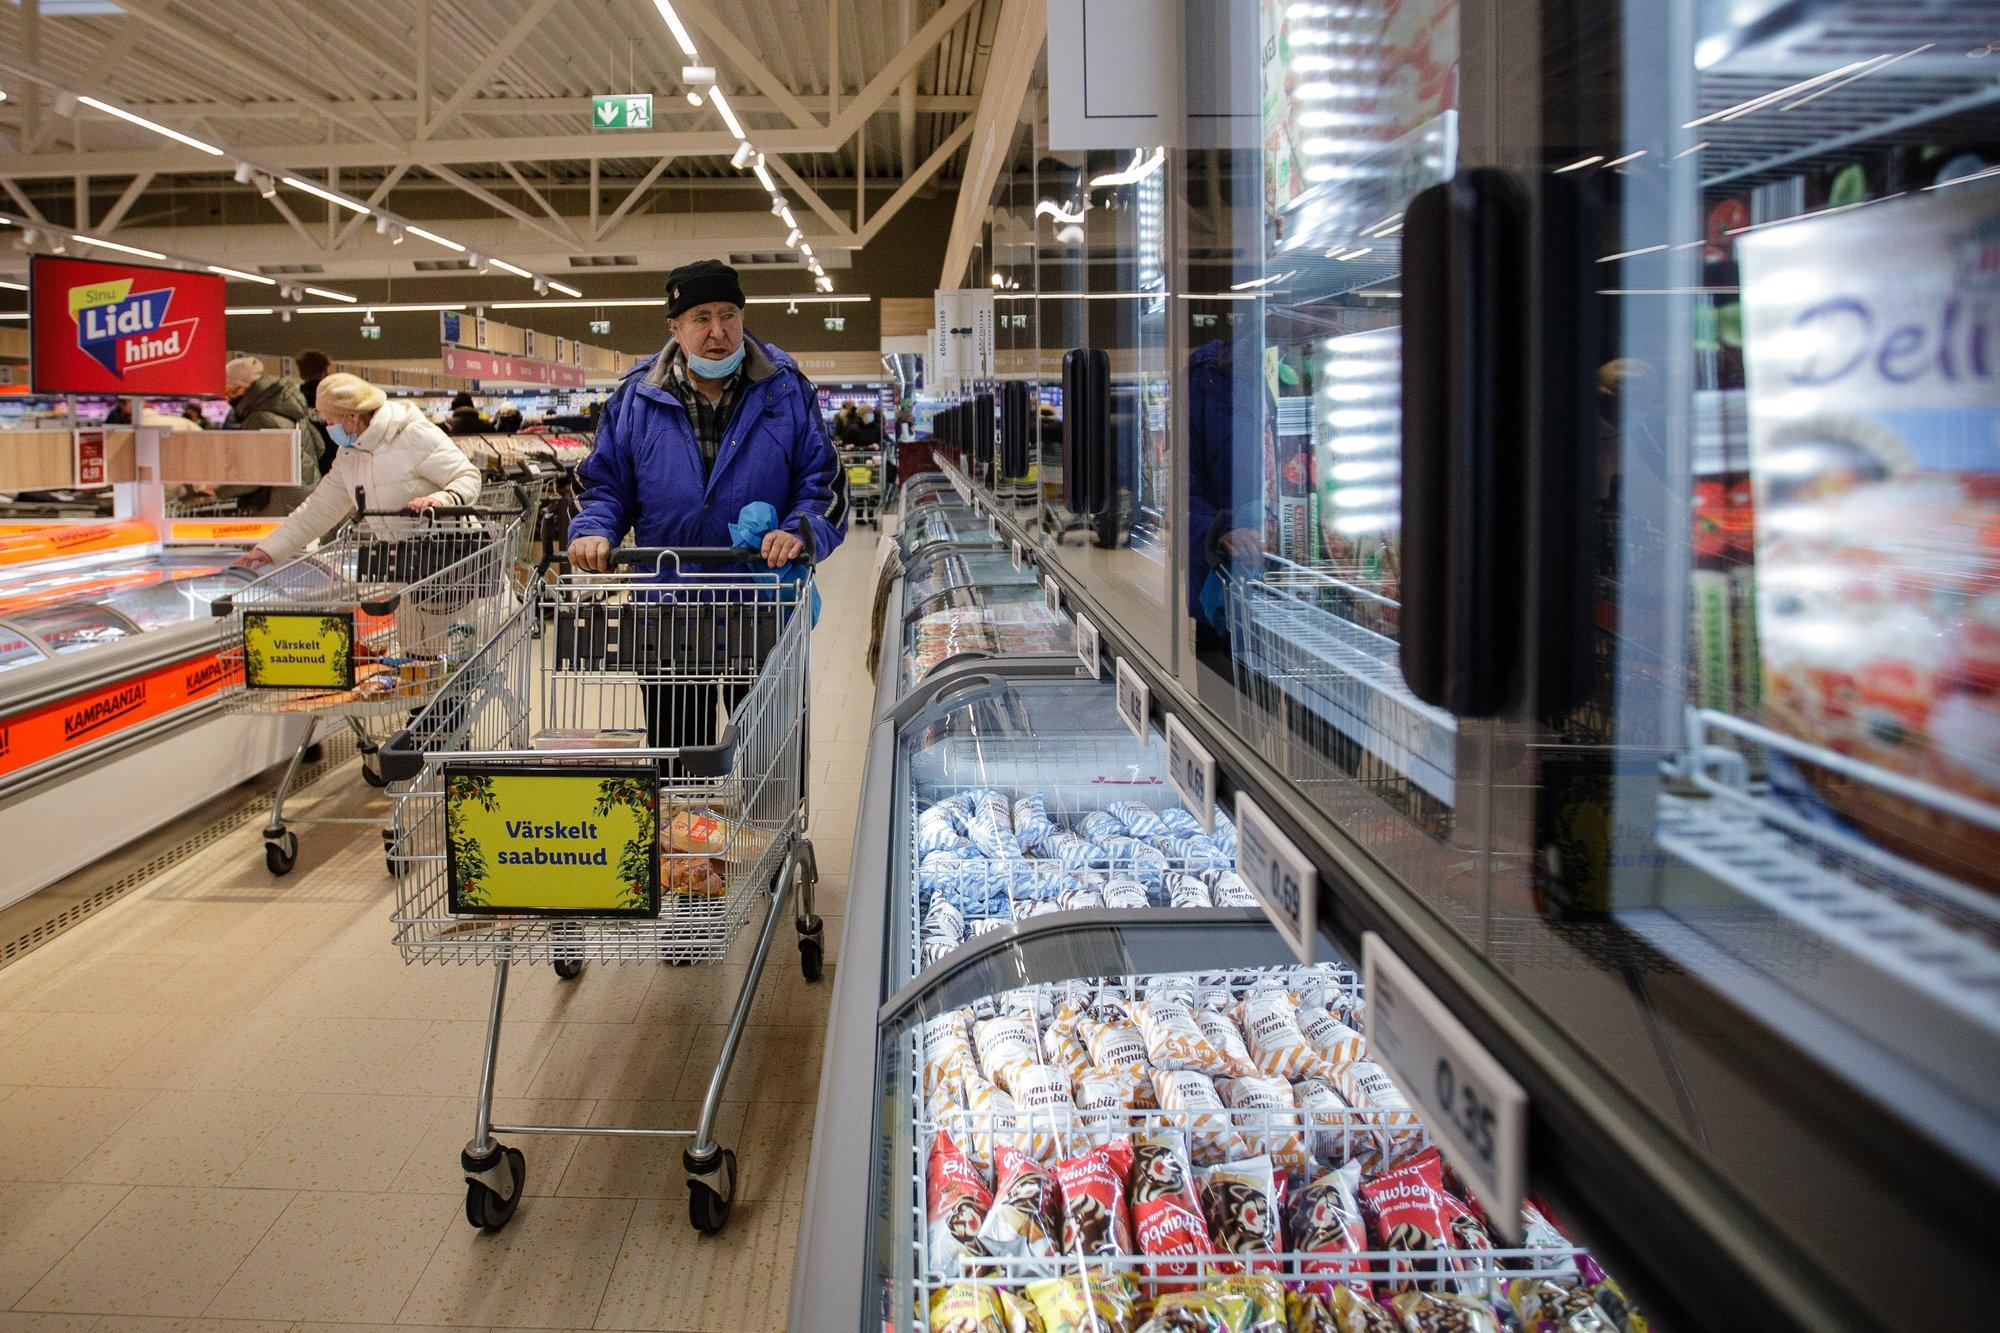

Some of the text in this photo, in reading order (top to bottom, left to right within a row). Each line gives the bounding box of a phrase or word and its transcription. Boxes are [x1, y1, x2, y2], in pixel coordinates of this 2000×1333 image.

[86, 289, 115, 303] Sinu
[86, 300, 154, 340] Lidl
[125, 331, 180, 363] hind
[274, 639, 320, 651] Värskelt
[270, 653, 326, 665] saabunud
[65, 682, 146, 735] KAMPAANIA!
[505, 821, 598, 839] Värskelt
[497, 848, 608, 866] saabunud
